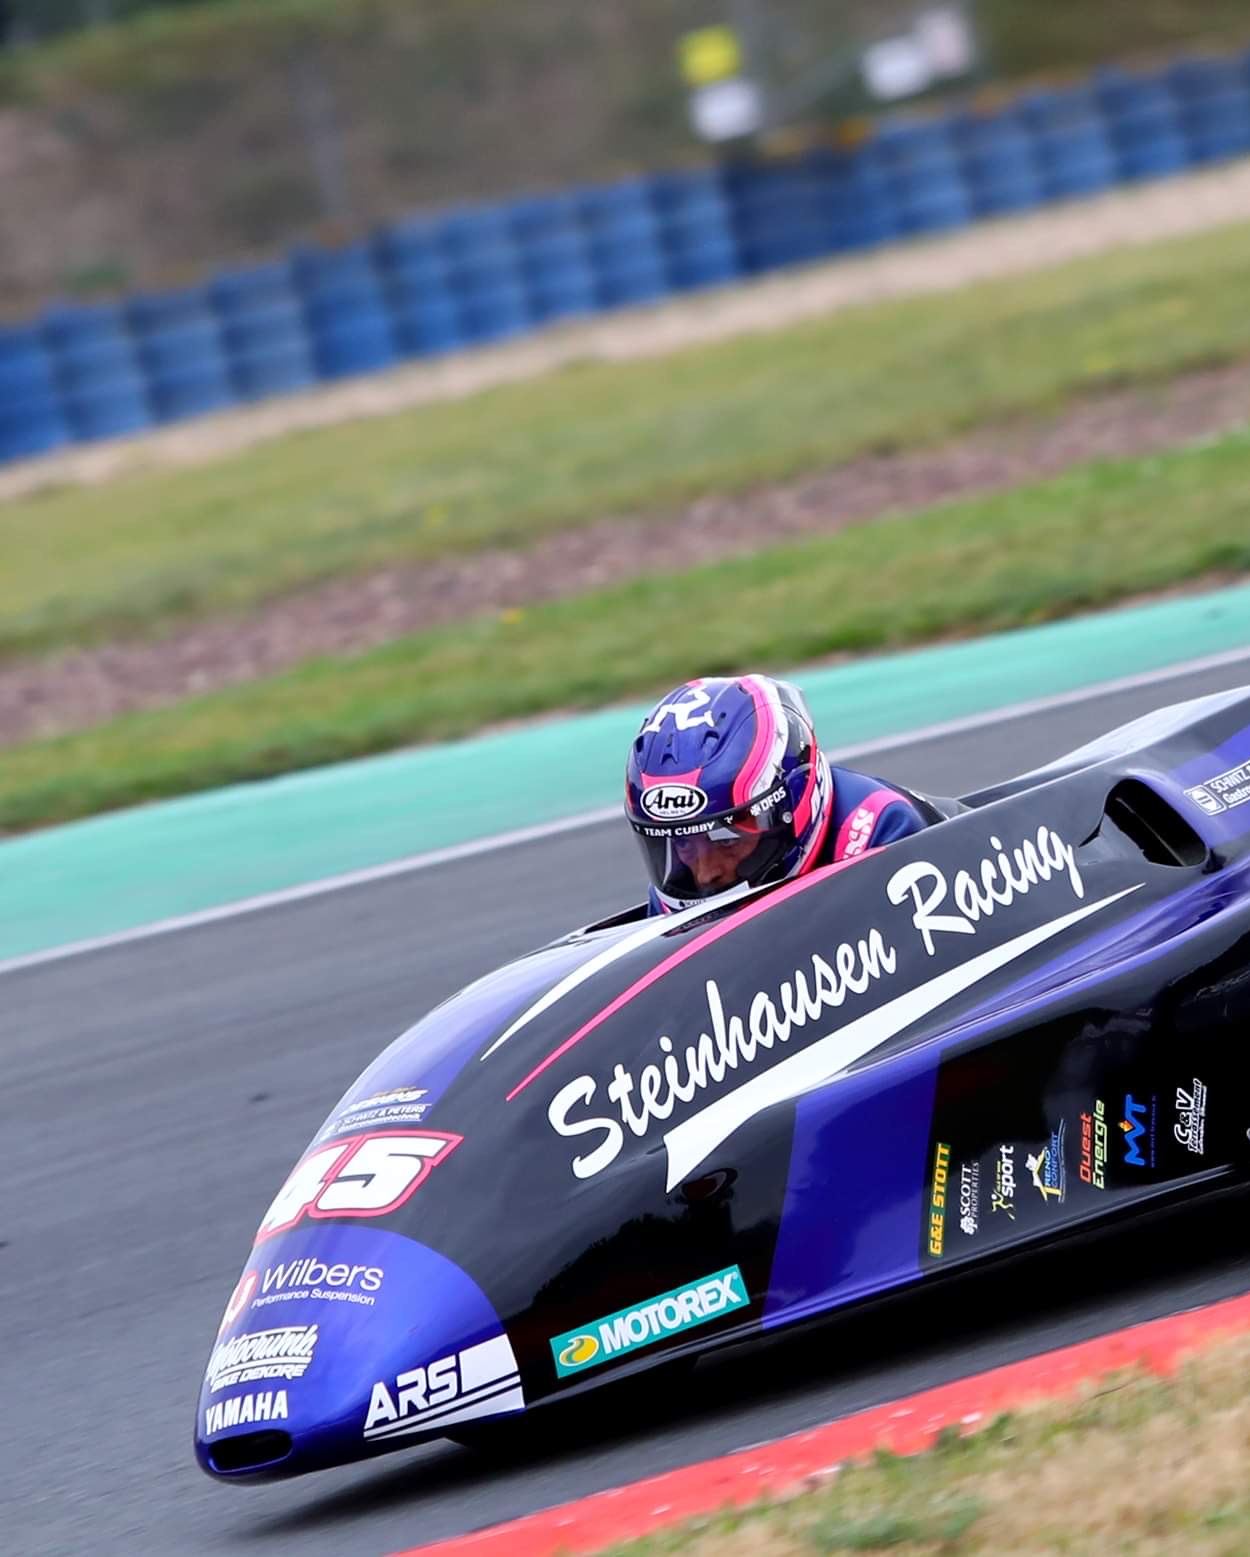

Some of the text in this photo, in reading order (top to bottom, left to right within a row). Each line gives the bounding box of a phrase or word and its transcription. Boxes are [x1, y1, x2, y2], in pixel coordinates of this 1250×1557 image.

[645, 788, 696, 810] Arai
[761, 786, 787, 811] DFDS
[644, 821, 716, 837] TEAM CUBBY
[548, 926, 896, 1180] Steinhausen
[887, 826, 1086, 955] Racing
[1092, 1099, 1108, 1190] Energie
[1124, 1094, 1147, 1167] MVT
[255, 1131, 464, 1246] 45
[960, 1163, 972, 1217] SCOTT
[970, 1161, 980, 1219] PROPERTIES
[1000, 1144, 1016, 1198] sport
[1044, 1150, 1052, 1187] RENO
[929, 1143, 950, 1256] G&E STOTT
[250, 1288, 376, 1309] Performance Suspension
[261, 1257, 384, 1292] Wilbers
[598, 1272, 741, 1355] MOTOREX
[205, 1389, 289, 1436] YAMAHA
